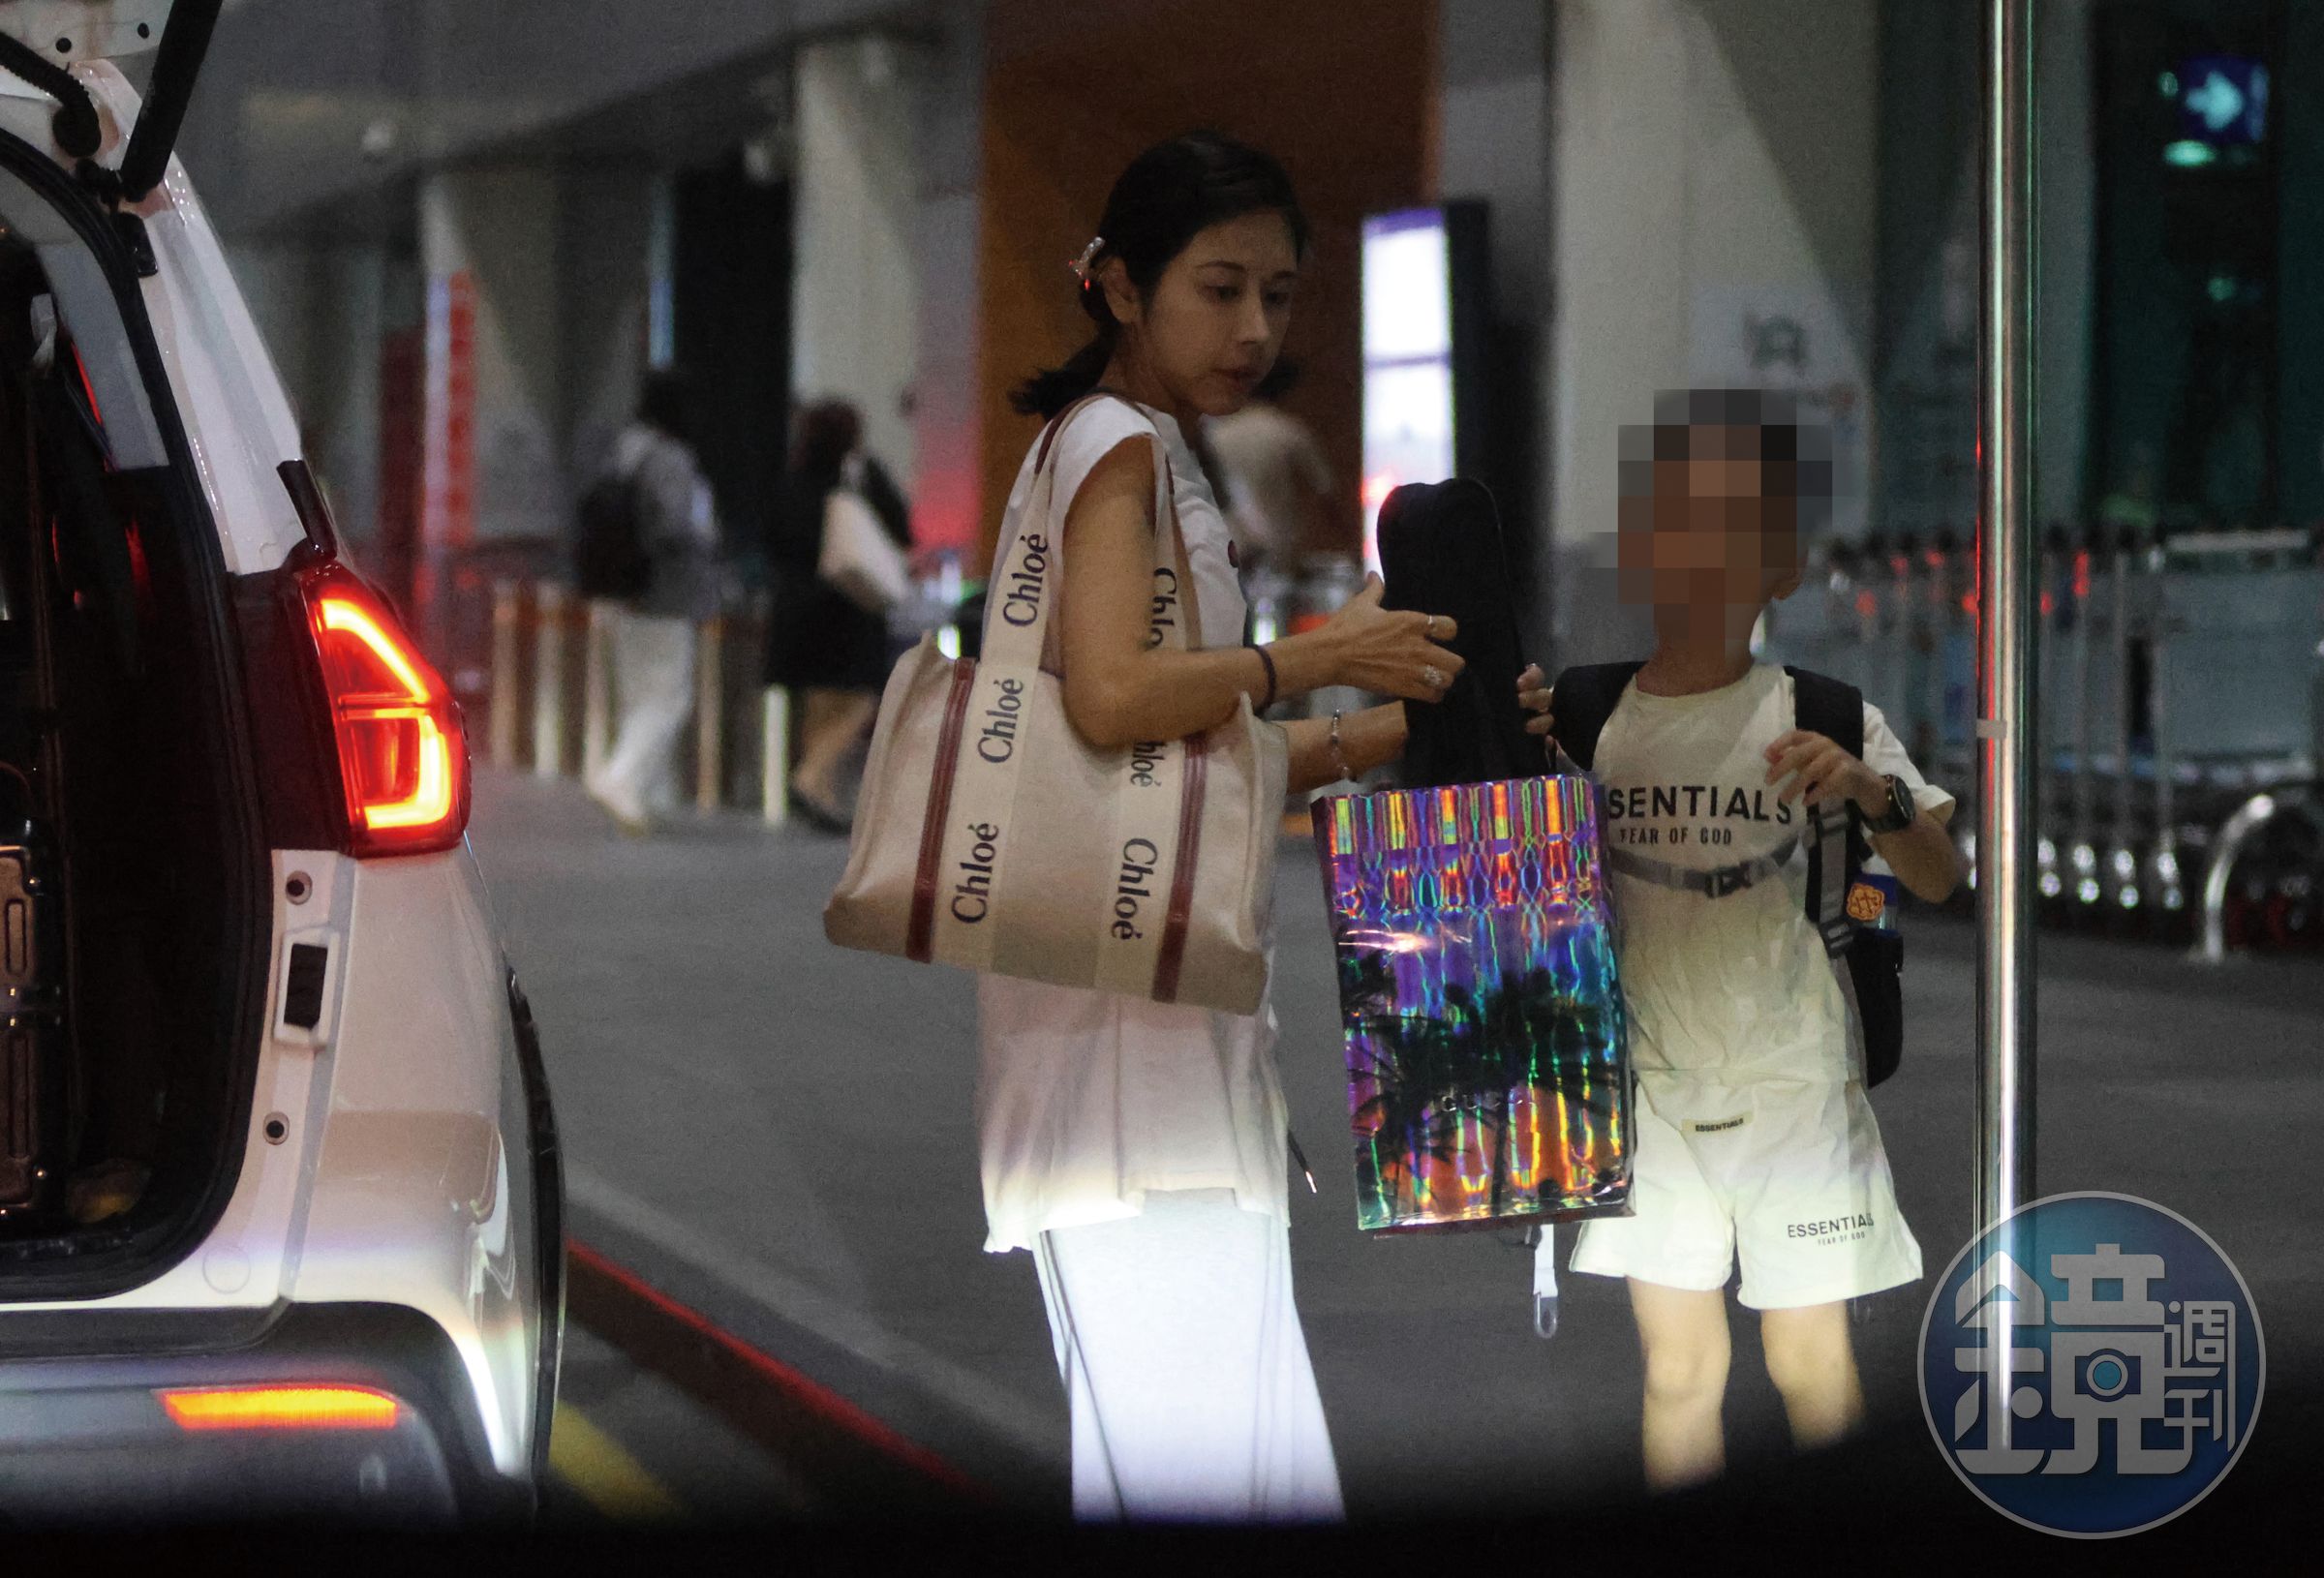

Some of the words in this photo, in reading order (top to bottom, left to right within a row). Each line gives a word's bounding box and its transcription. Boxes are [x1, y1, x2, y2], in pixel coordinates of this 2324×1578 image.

[1003, 532, 1048, 627] Chloé
[978, 678, 1024, 764] Chloé
[1130, 741, 1167, 788] hloé
[1608, 785, 1791, 824] SENTIALS
[951, 823, 1000, 925] Chloé
[1620, 828, 1659, 845] FEAR
[1669, 828, 1689, 844] OF
[1699, 827, 1732, 845] GOD
[1111, 837, 1158, 941] Chloé
